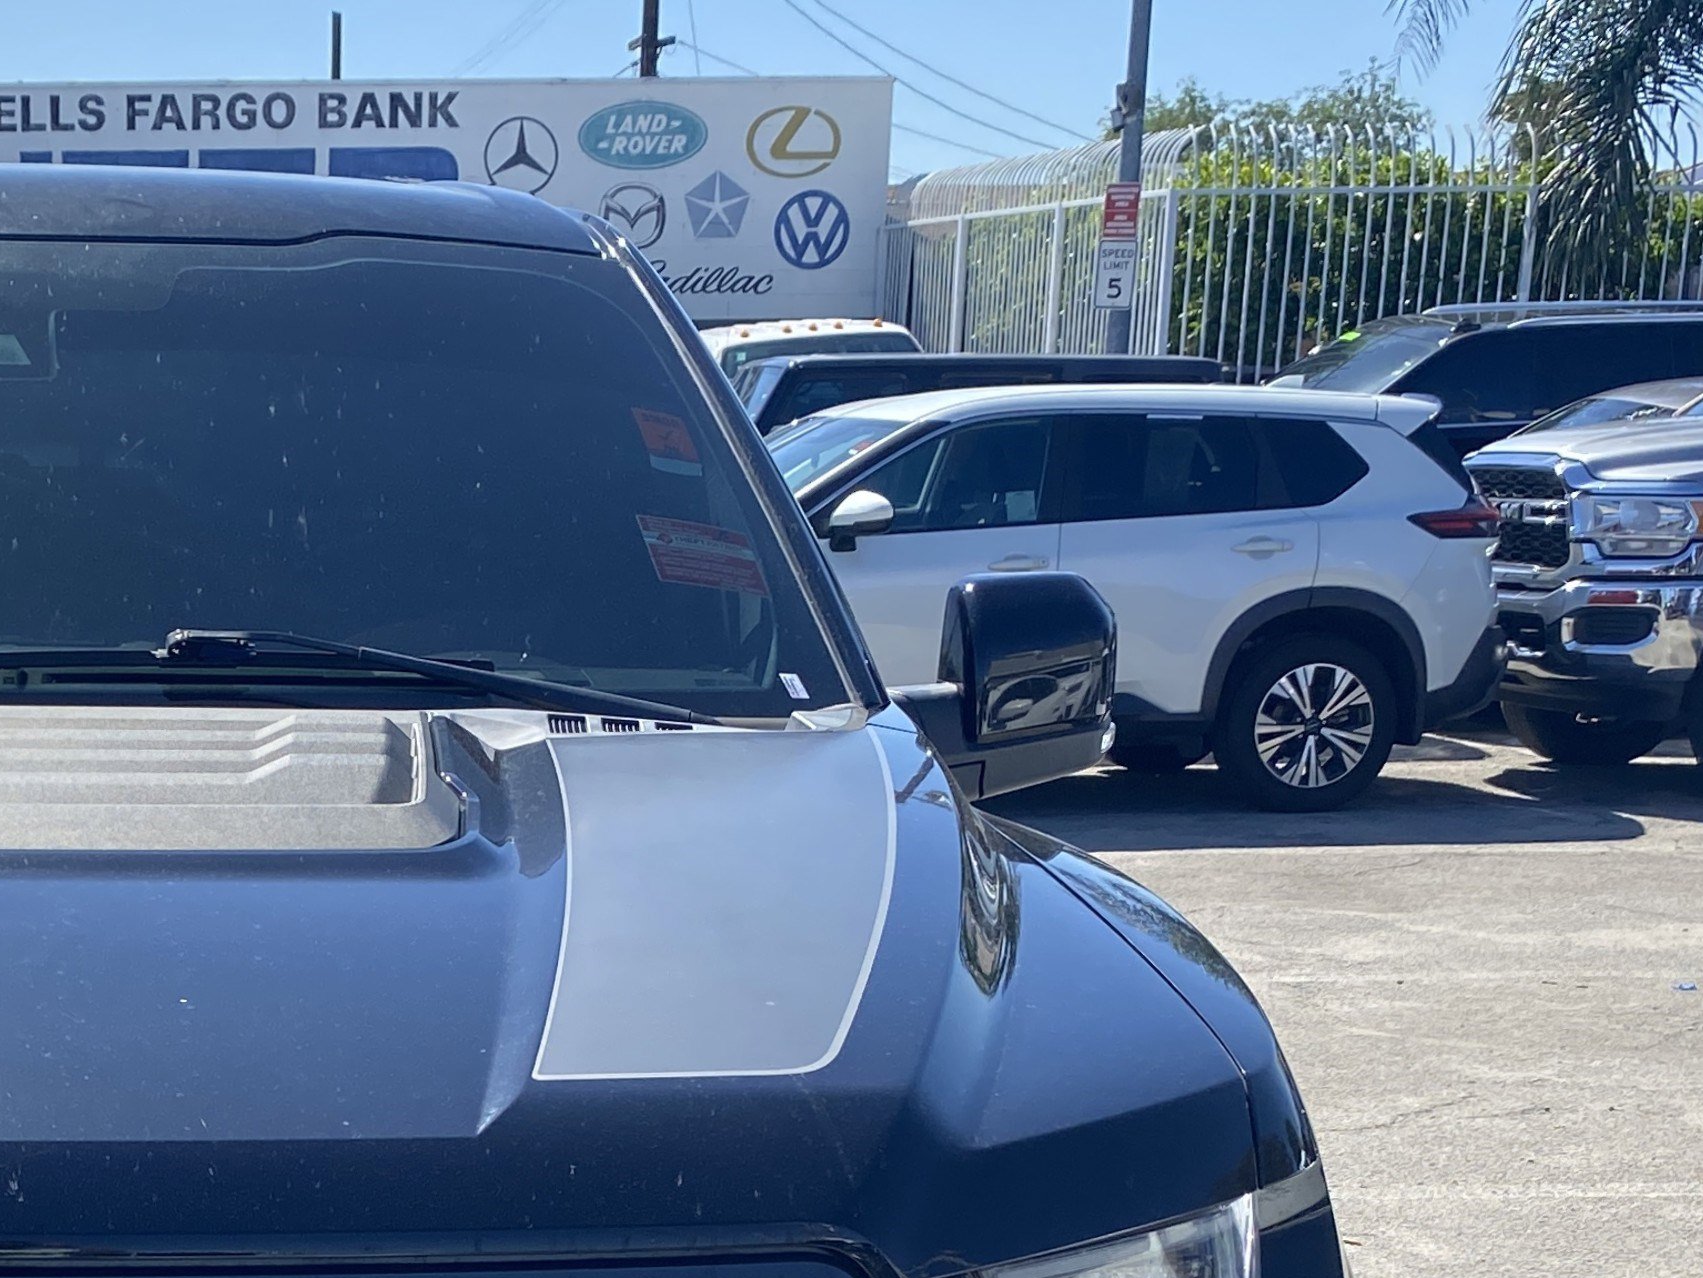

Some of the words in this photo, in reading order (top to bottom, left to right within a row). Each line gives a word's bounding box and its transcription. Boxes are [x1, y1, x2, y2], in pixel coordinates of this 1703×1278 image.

[126, 91, 296, 131] FARGO
[317, 91, 461, 130] BANK
[1102, 248, 1134, 259] SPEED
[1103, 260, 1130, 271] LIMIT
[1106, 277, 1122, 299] 5
